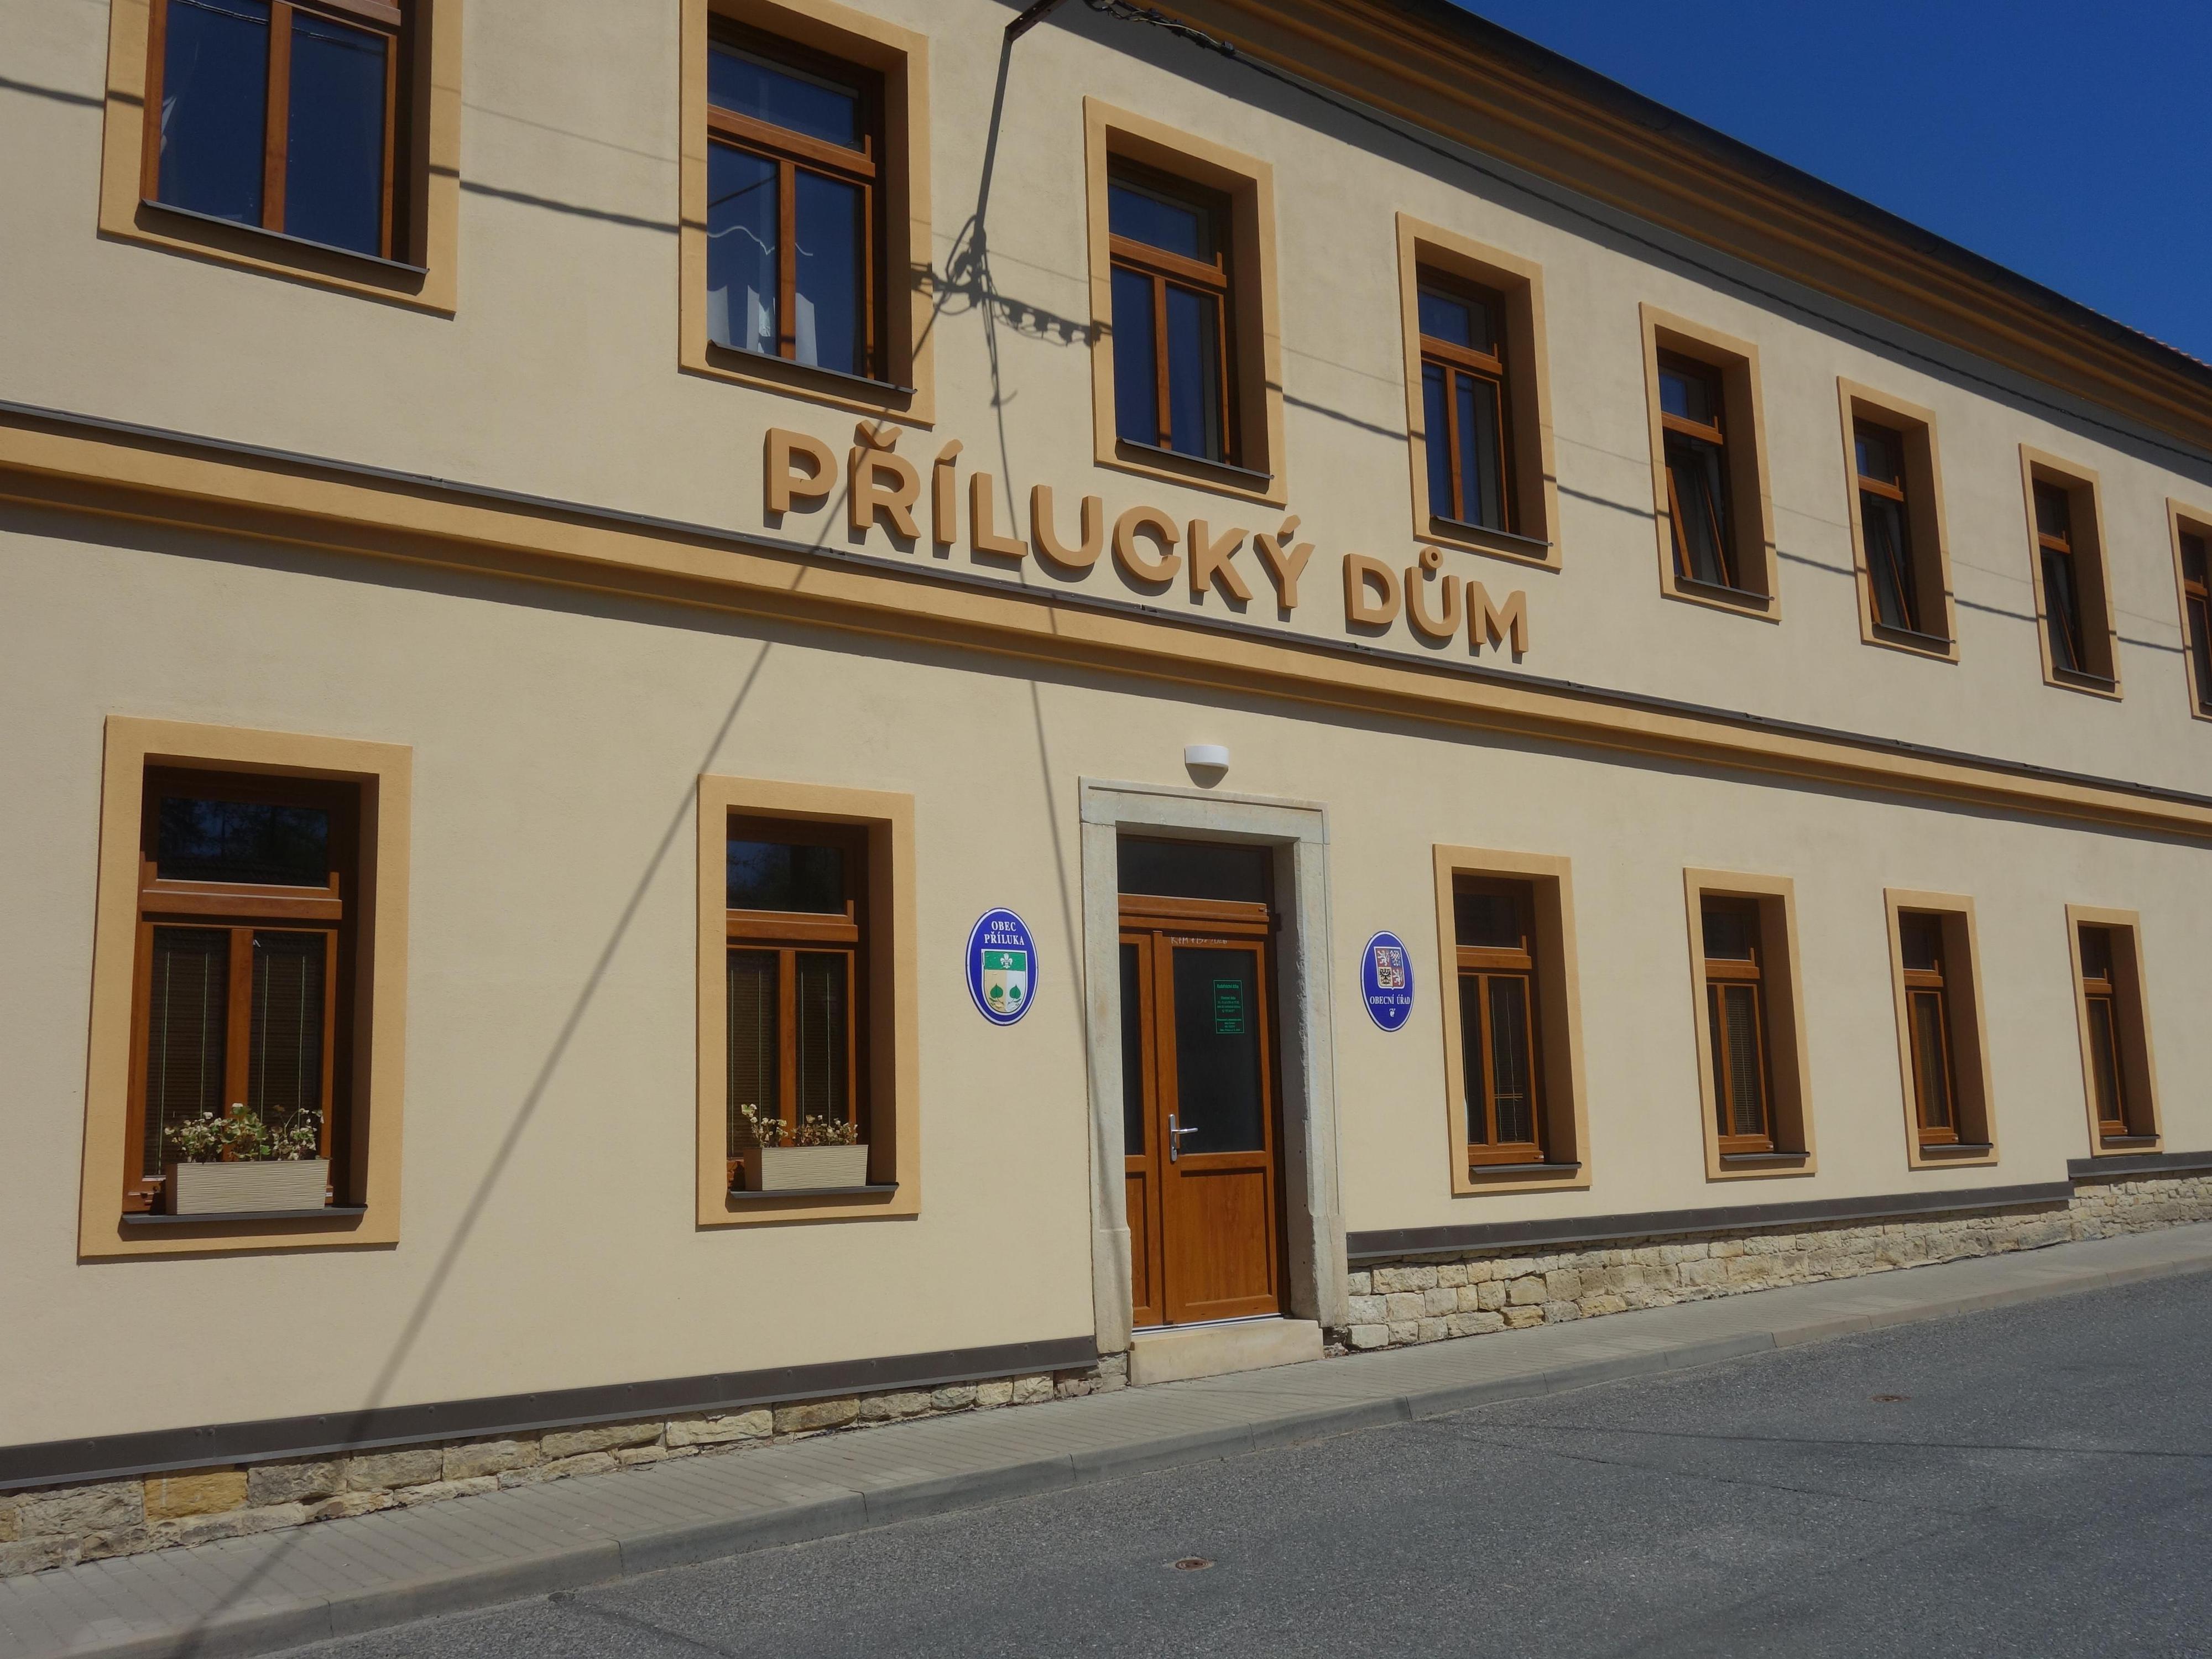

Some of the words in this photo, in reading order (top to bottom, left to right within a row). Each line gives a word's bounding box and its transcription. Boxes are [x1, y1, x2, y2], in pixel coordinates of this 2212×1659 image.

[765, 419, 1316, 609] PŘÍLUCKÝ
[1343, 545, 1530, 654] DŮM
[992, 921, 1016, 931] OBEC
[984, 931, 1025, 945] PŘÍLUKA
[1369, 994, 1394, 1005] OBECNÍ
[1396, 994, 1411, 1005] ÚŘAD
